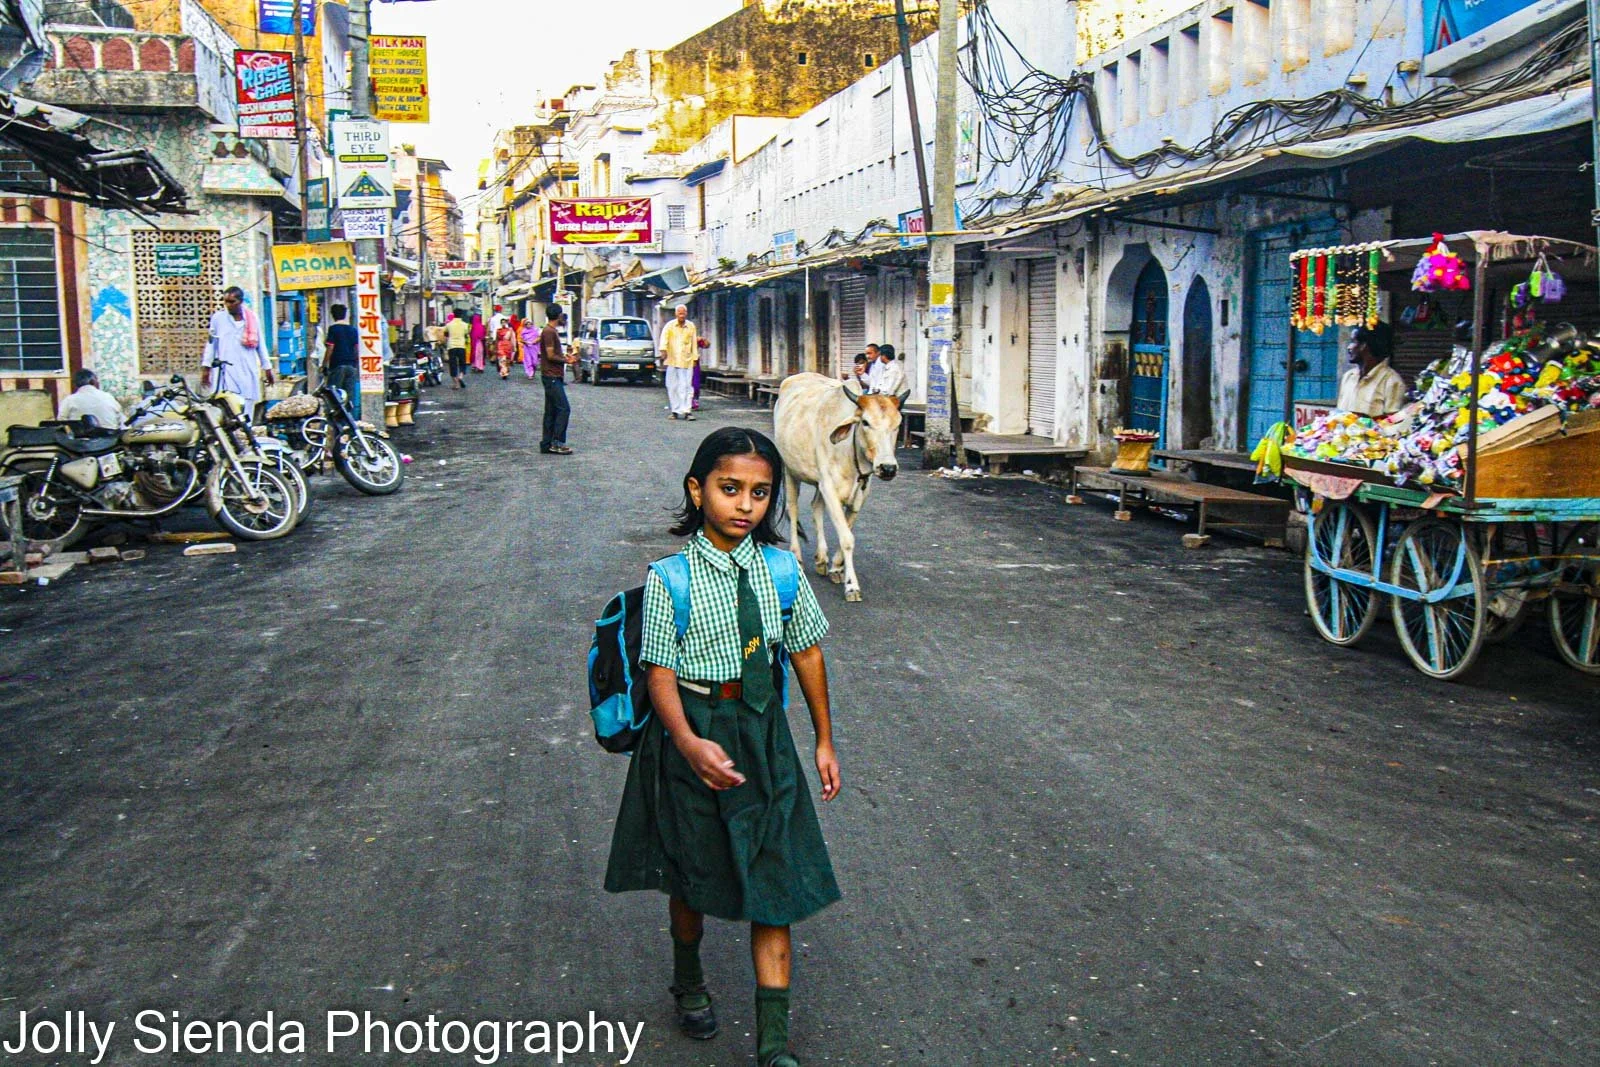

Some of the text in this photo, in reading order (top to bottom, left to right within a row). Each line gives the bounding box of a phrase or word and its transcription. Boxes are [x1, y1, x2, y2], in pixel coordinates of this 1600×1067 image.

[372, 39, 423, 48] MILK MAN
[397, 49, 420, 57] HOUSE
[241, 63, 290, 90] ROSE
[255, 78, 292, 100] CAFE
[272, 112, 294, 123] FOOD
[344, 131, 381, 141] THIRD
[350, 144, 376, 153] EYE
[575, 202, 627, 219] Raju
[347, 223, 379, 231] SCHOOL
[554, 220, 648, 231] Terrace Garden Restaurant
[281, 256, 352, 272] AROMA
[438, 261, 467, 270] SANJAY
[360, 356, 382, 373] घाट
